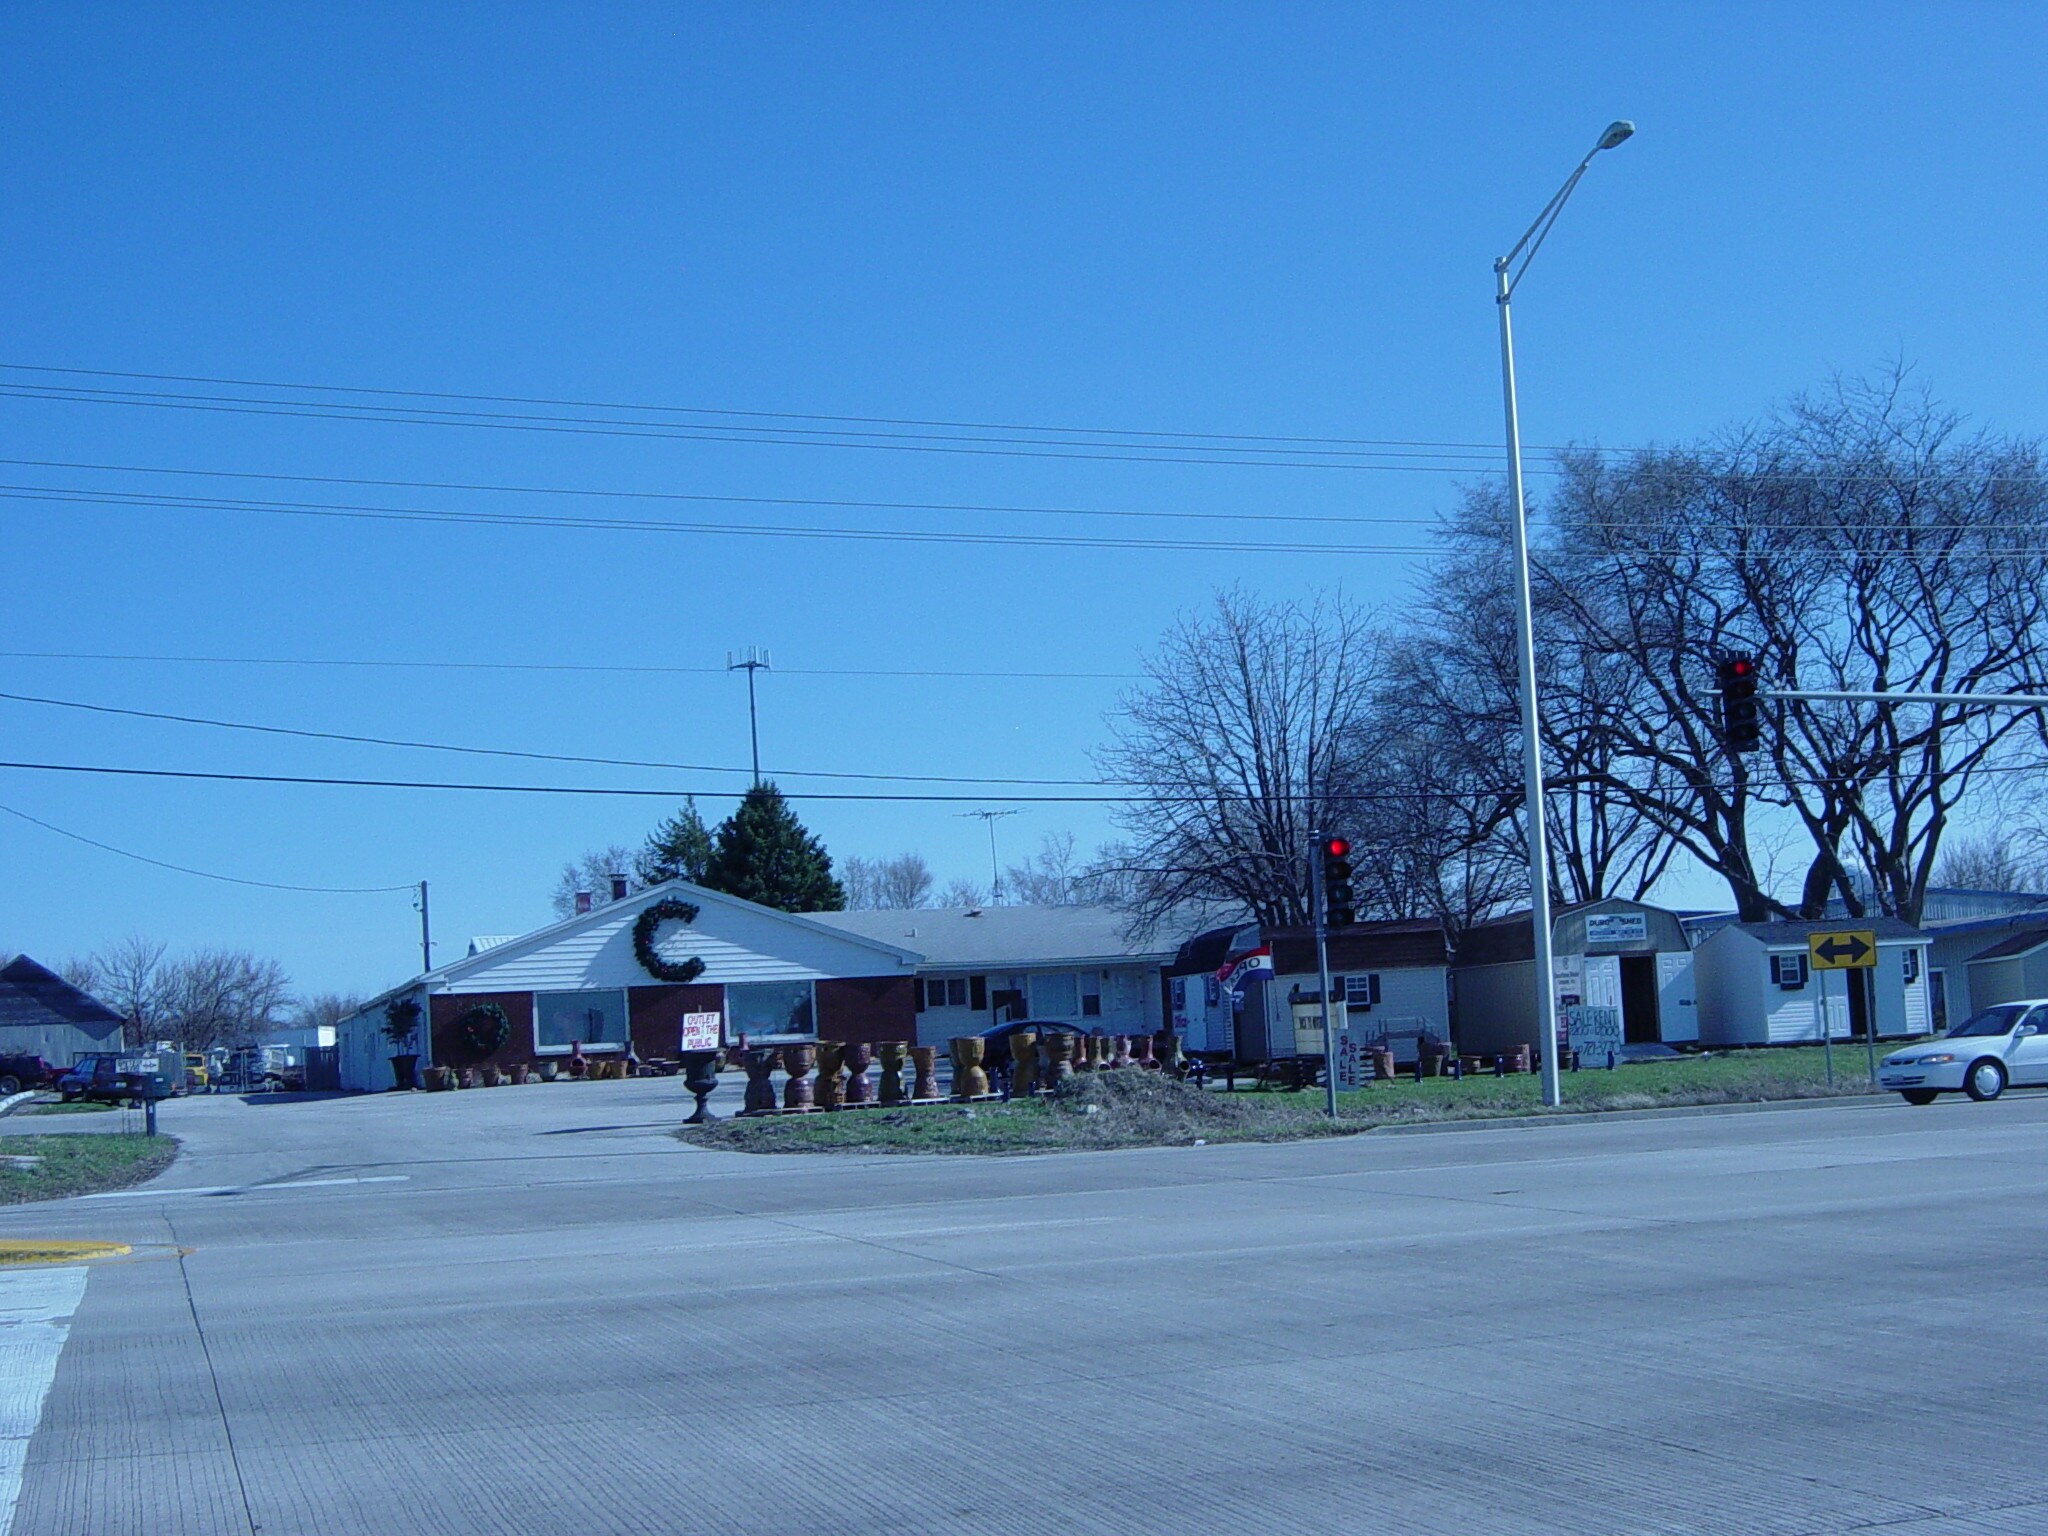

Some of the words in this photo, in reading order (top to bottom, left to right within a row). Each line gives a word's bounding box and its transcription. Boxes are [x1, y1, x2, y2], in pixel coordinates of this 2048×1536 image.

[687, 1013, 716, 1025] OUTLET
[1569, 1009, 1592, 1027] SALE
[1593, 1009, 1619, 1027] RENT
[683, 1026, 701, 1037] OPEN
[706, 1024, 719, 1035] THE
[687, 1036, 712, 1049] PUBLIC
[1339, 1035, 1349, 1082] SALE
[1348, 1042, 1358, 1087] SALE
